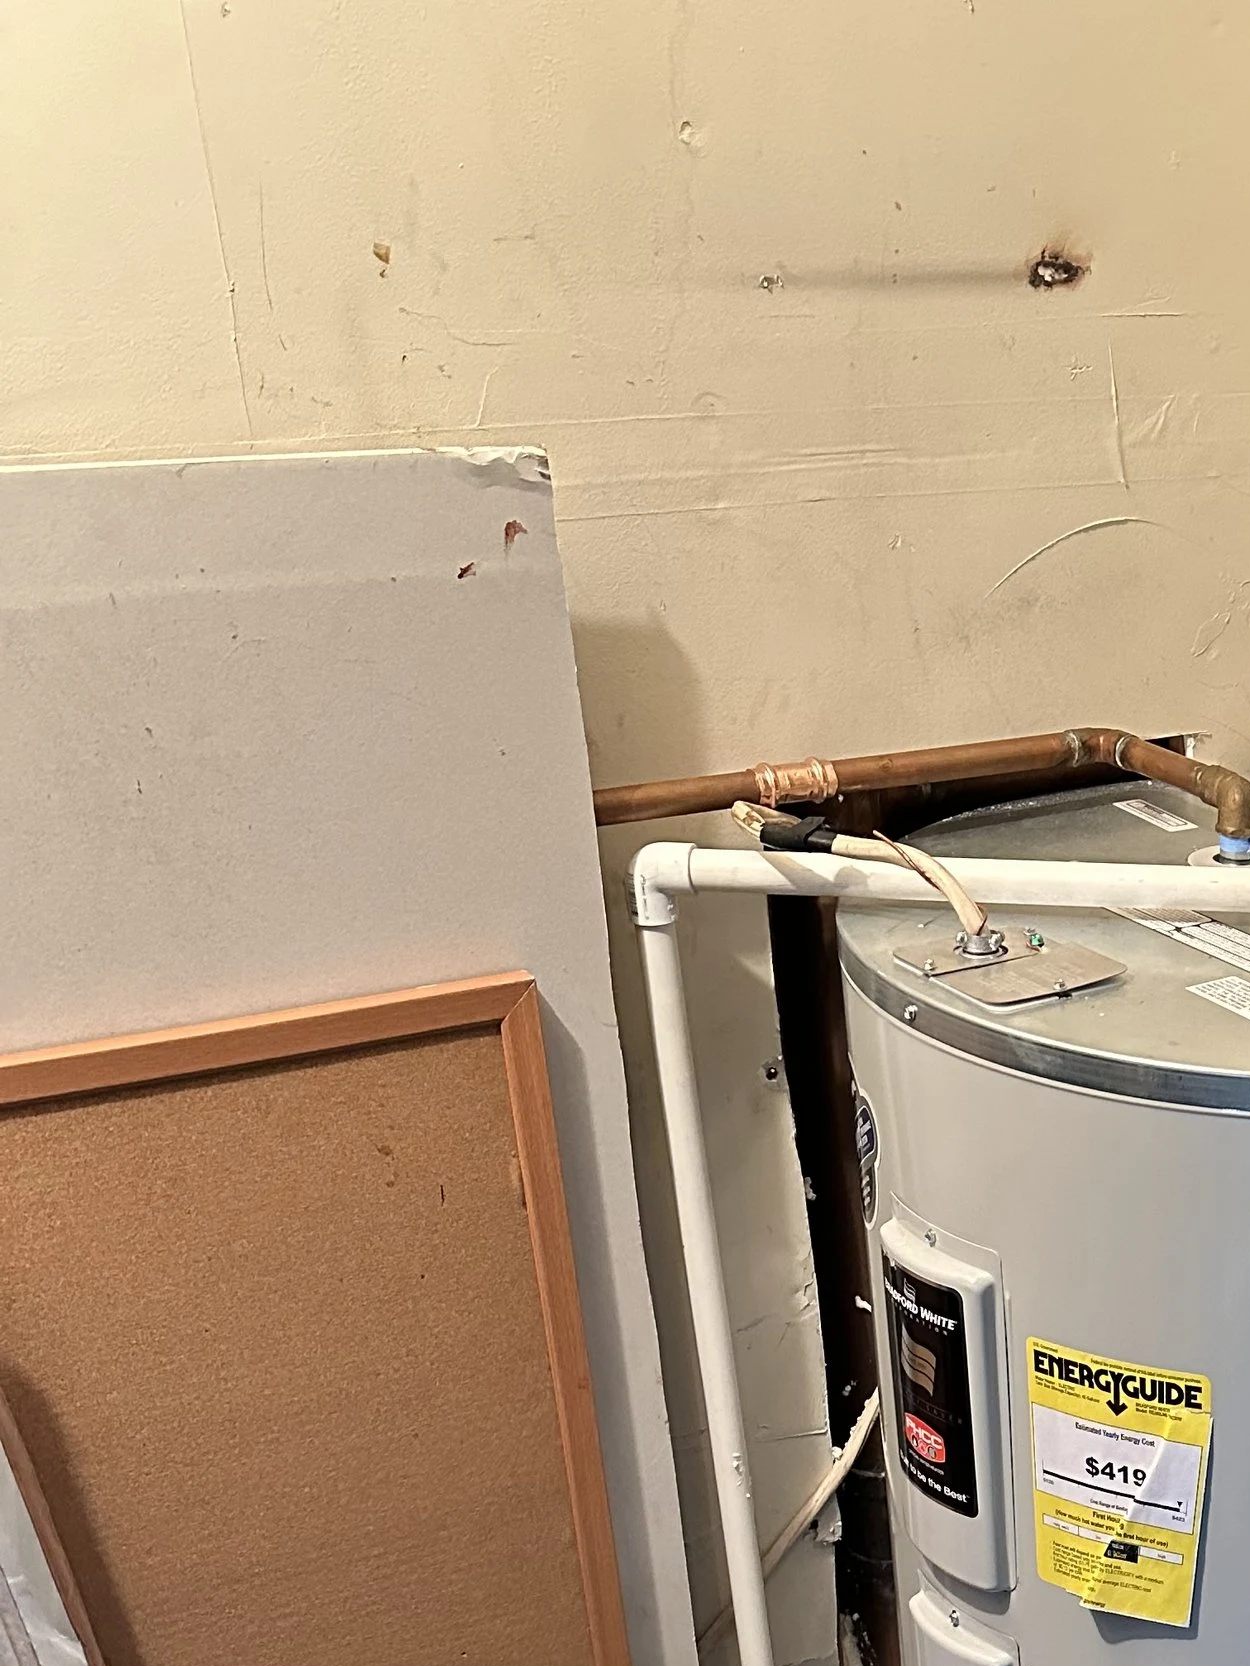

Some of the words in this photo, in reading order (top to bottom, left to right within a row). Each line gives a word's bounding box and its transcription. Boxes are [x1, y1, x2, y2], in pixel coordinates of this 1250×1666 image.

[885, 1277, 918, 1314] BRADFORD
[920, 1306, 956, 1330] WHITE
[1034, 1349, 1203, 1411] ENERGYGUIDE
[906, 1416, 943, 1450] PHCC
[1075, 1422, 1101, 1435] Estimated
[1103, 1429, 1119, 1441] Yearly
[1121, 1434, 1140, 1445] Energy
[1142, 1438, 1155, 1447] Cost
[910, 1463, 917, 1475] to
[917, 1469, 927, 1483] be
[928, 1477, 942, 1492] the
[944, 1486, 968, 1503] Best
[1085, 1456, 1147, 1487] $419
[1055, 1509, 1066, 1518] (How
[1067, 1512, 1081, 1521] much
[1082, 1516, 1090, 1524] hot
[1091, 1520, 1105, 1529] water
[1093, 1511, 1105, 1520] First
[1123, 1533, 1135, 1541] first
[1135, 1535, 1149, 1543] hour
